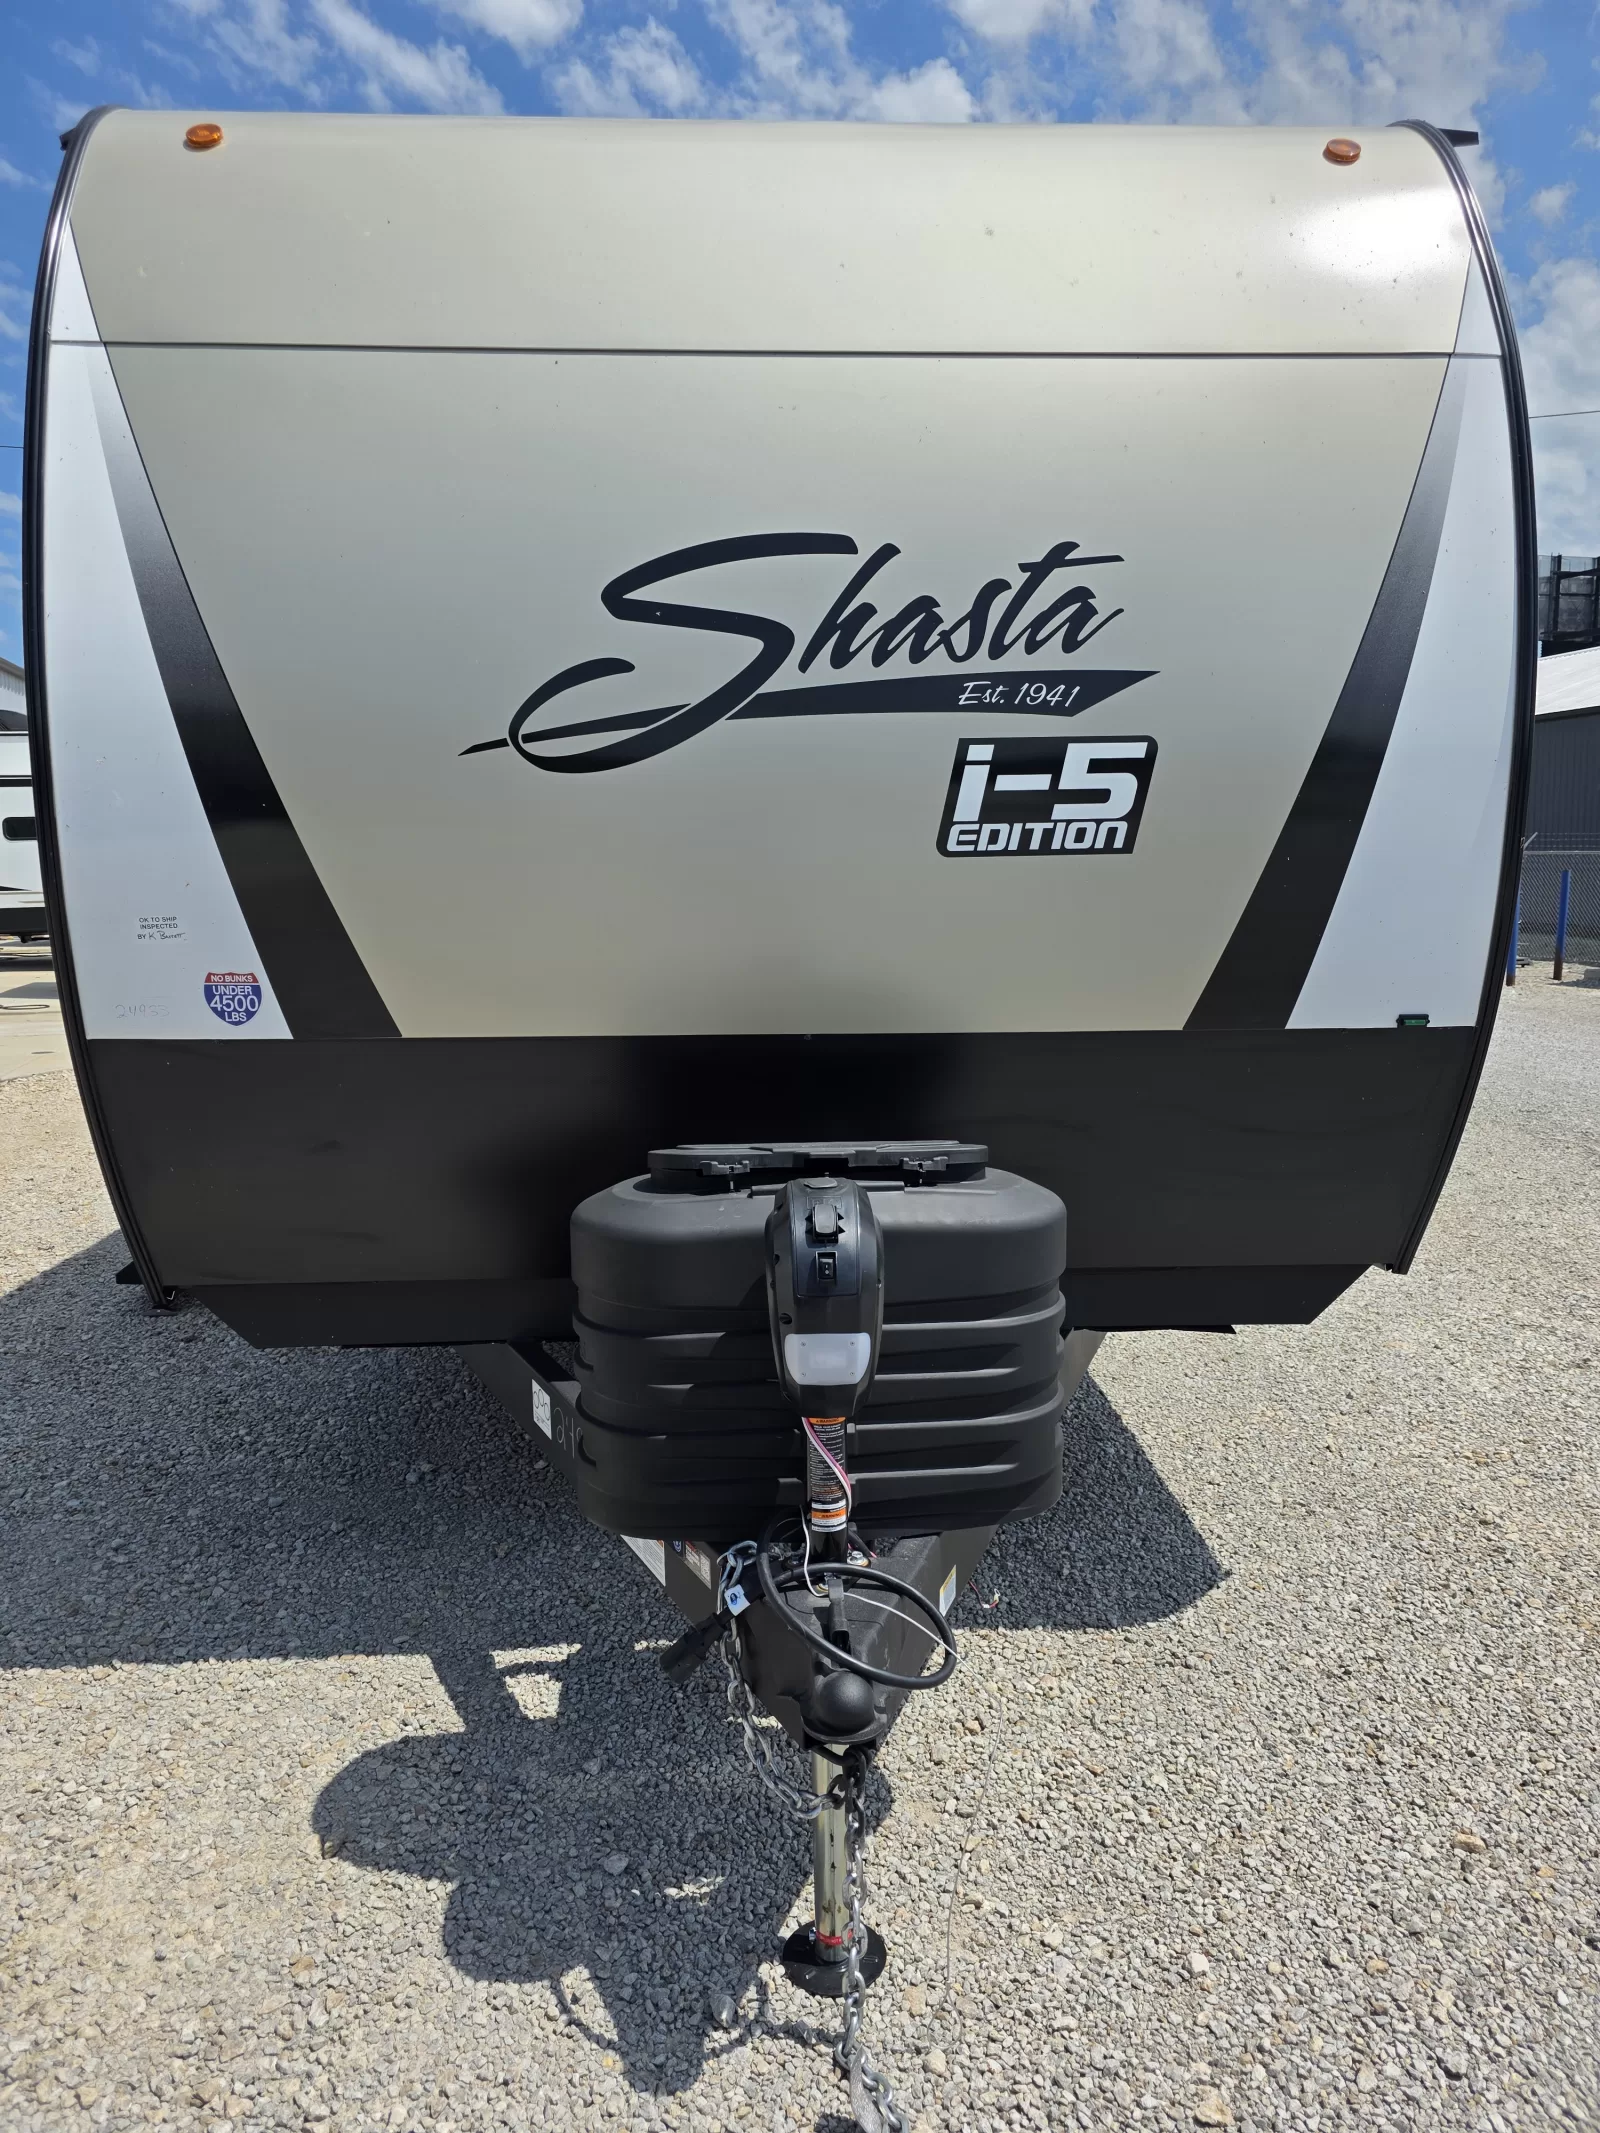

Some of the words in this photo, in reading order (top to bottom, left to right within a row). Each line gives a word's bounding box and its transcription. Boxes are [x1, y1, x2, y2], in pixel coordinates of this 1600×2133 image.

[508, 532, 1126, 775] Shasta
[958, 681, 1009, 705] Est.
[1014, 682, 1081, 707] 1941
[952, 741, 1149, 822] i-5
[946, 820, 1128, 852] EDITION
[212, 985, 253, 995] UNDER
[209, 995, 259, 1012] 4500
[224, 1011, 247, 1022] LBS
